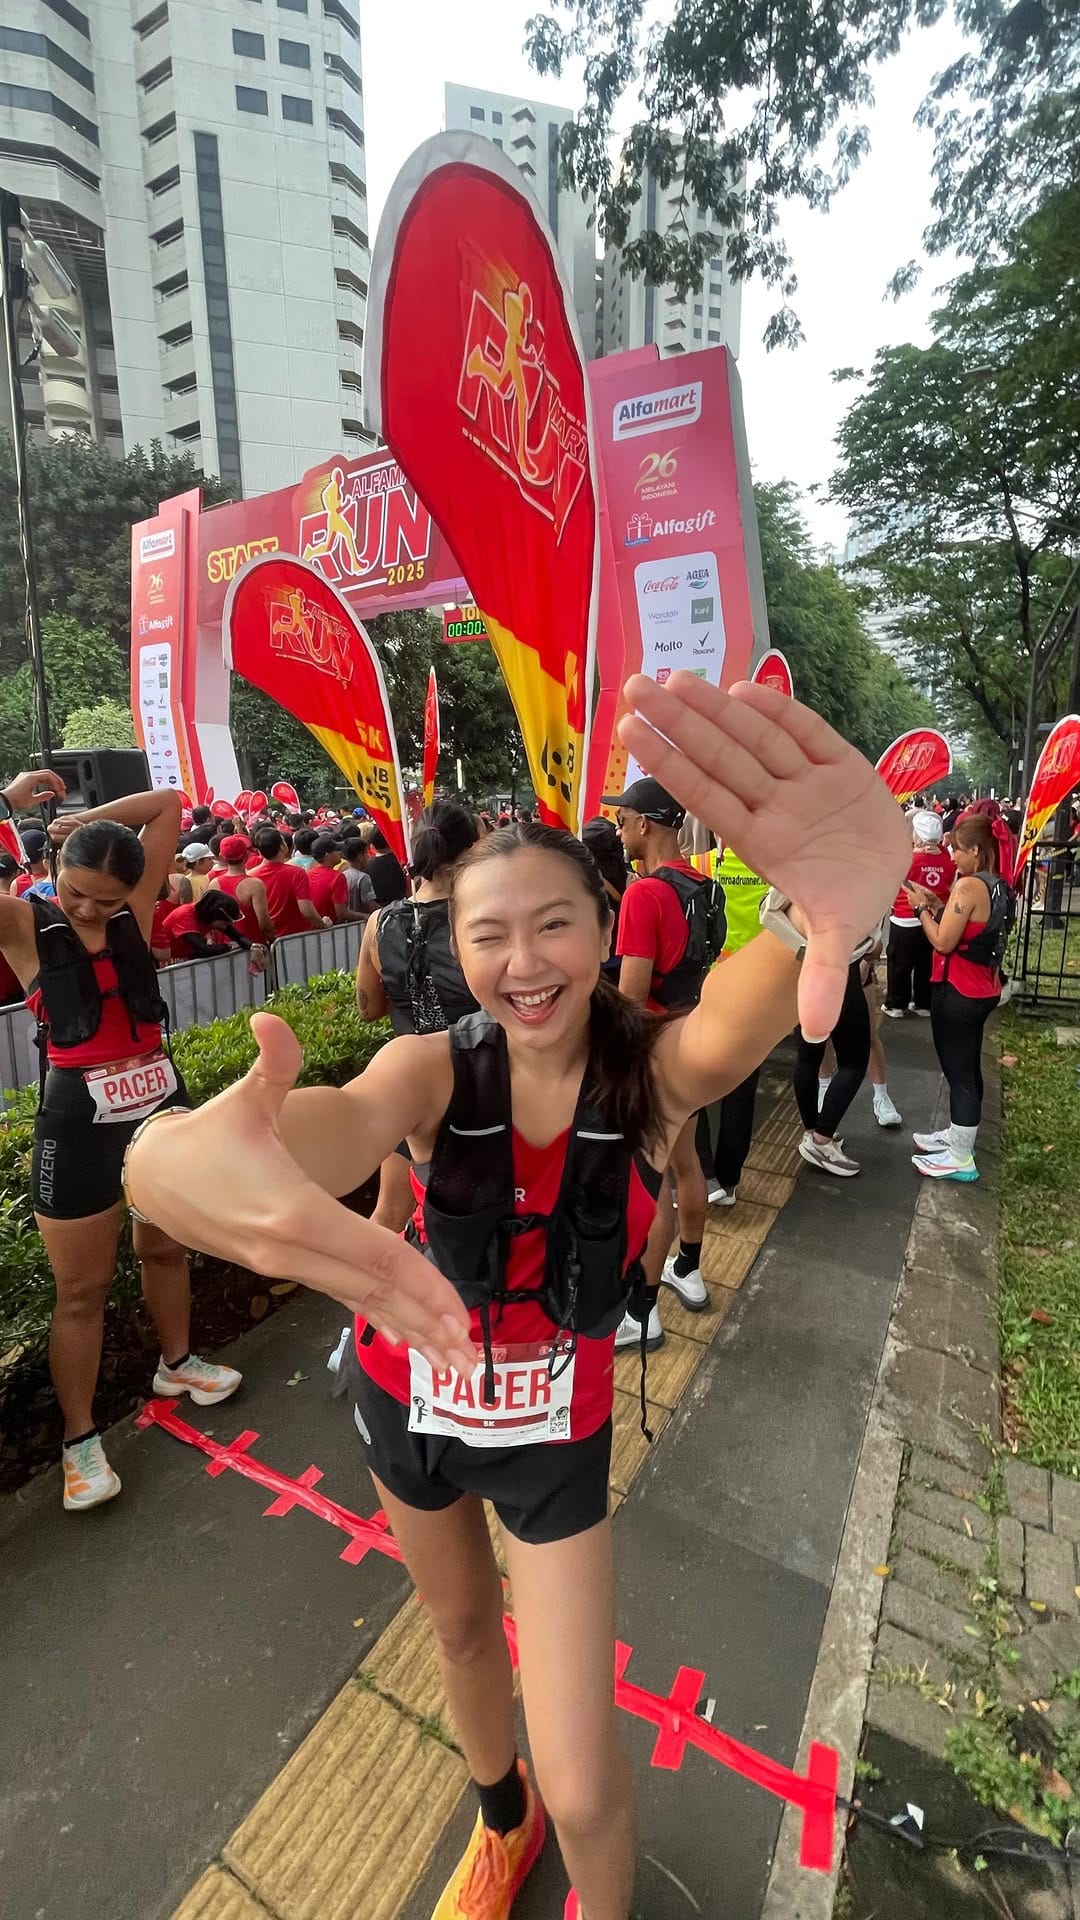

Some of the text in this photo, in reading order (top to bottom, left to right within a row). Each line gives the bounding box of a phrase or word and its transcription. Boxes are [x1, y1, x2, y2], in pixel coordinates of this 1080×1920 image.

[618, 388, 697, 422] Alfamart
[352, 465, 408, 499] ALFAM
[634, 447, 681, 494] 26
[641, 482, 676, 494] MELAYANI
[641, 489, 678, 501] INDONESIA
[299, 487, 432, 582] RUN
[653, 509, 716, 537] Alfagift
[142, 533, 172, 550] Alfamart
[387, 561, 425, 586] 2025
[687, 568, 710, 581] AQUA
[648, 609, 679, 621] Wardah
[654, 640, 683, 653] Molto
[693, 647, 715, 656] Rexona
[103, 1066, 168, 1104] PACER
[39, 1139, 57, 1208] ADIZERO
[432, 1367, 551, 1412] PACER
